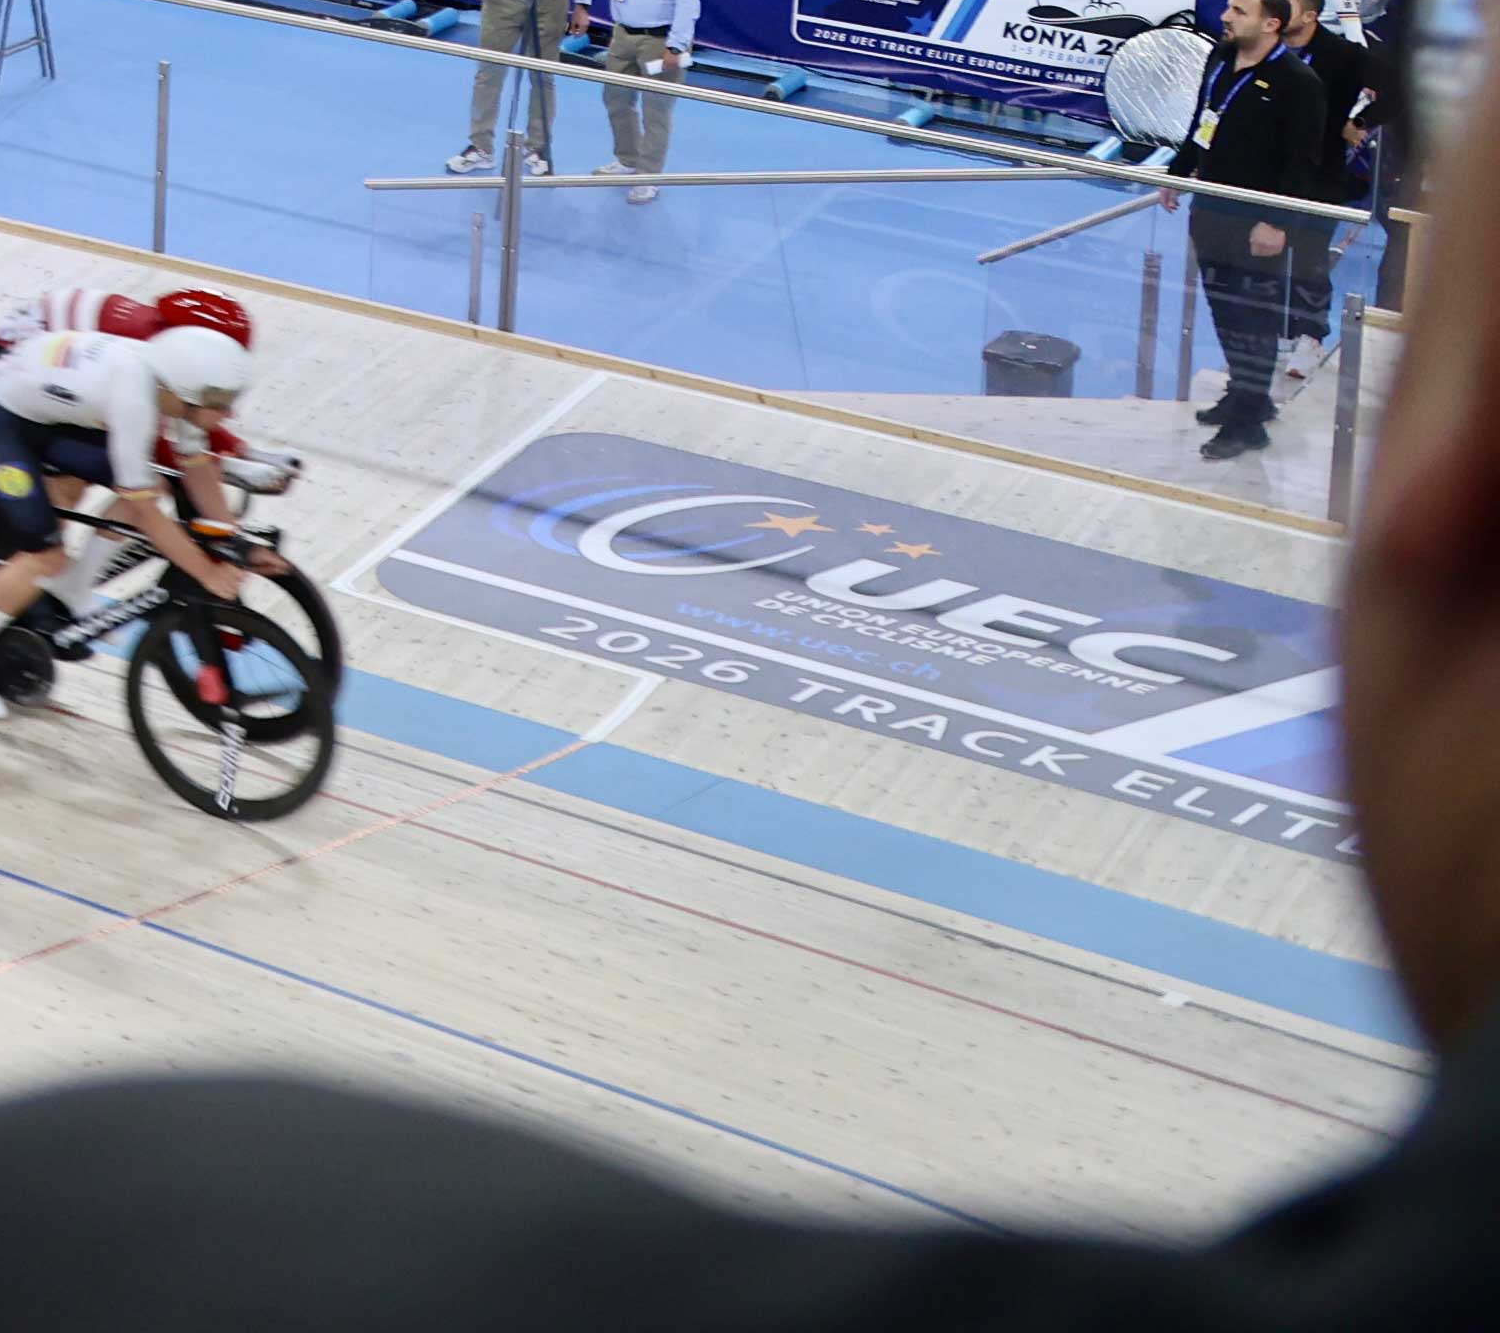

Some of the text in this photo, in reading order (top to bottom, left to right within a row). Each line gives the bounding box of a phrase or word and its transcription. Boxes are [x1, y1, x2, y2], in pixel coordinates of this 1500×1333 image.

[813, 29, 1041, 78] 2026 UEC TRACK ELITE EUROPEAN
[1003, 22, 1086, 55] KONYA
[1040, 50, 1106, 66] FEBRUAR
[674, 597, 941, 682] www.uec.ch
[753, 596, 1001, 668] DE CYCLISME
[774, 589, 1160, 696] UNION EUROPEENNE
[805, 557, 1239, 685] UEC
[538, 614, 752, 687] 2026
[789, 677, 1094, 779] TRACK
